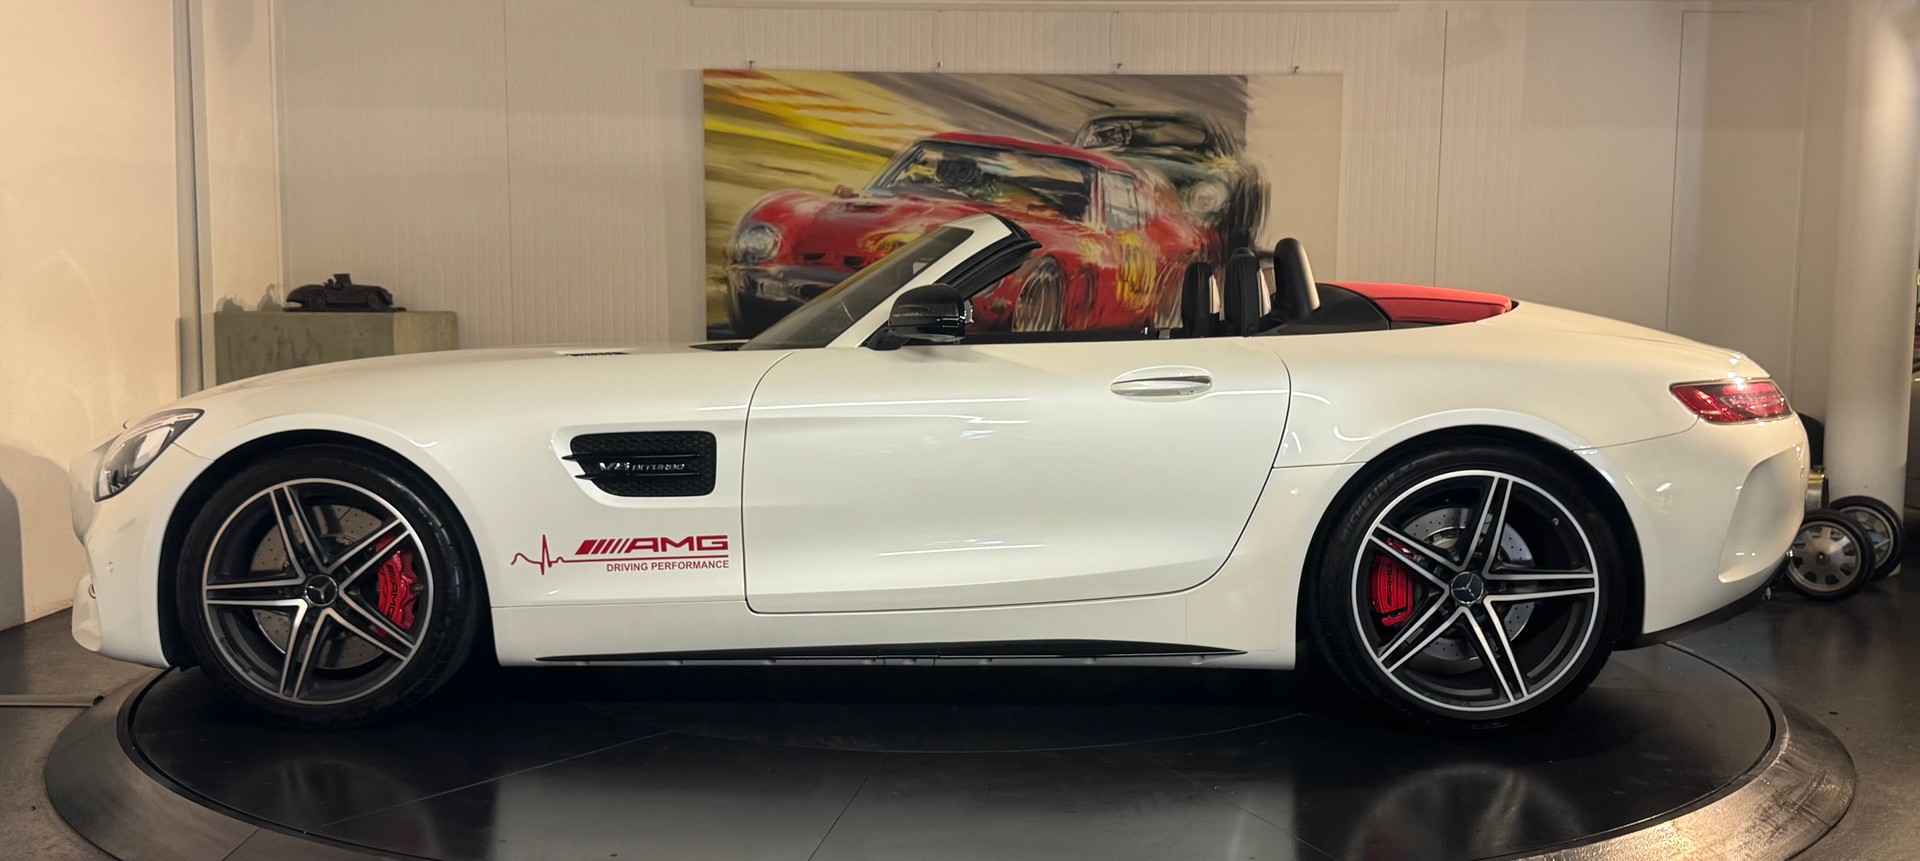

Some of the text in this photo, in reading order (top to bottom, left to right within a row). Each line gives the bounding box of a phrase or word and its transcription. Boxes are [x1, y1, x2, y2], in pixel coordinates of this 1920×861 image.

[624, 535, 729, 553] AMG
[606, 560, 729, 572] DRIVING PERFORMANCE
